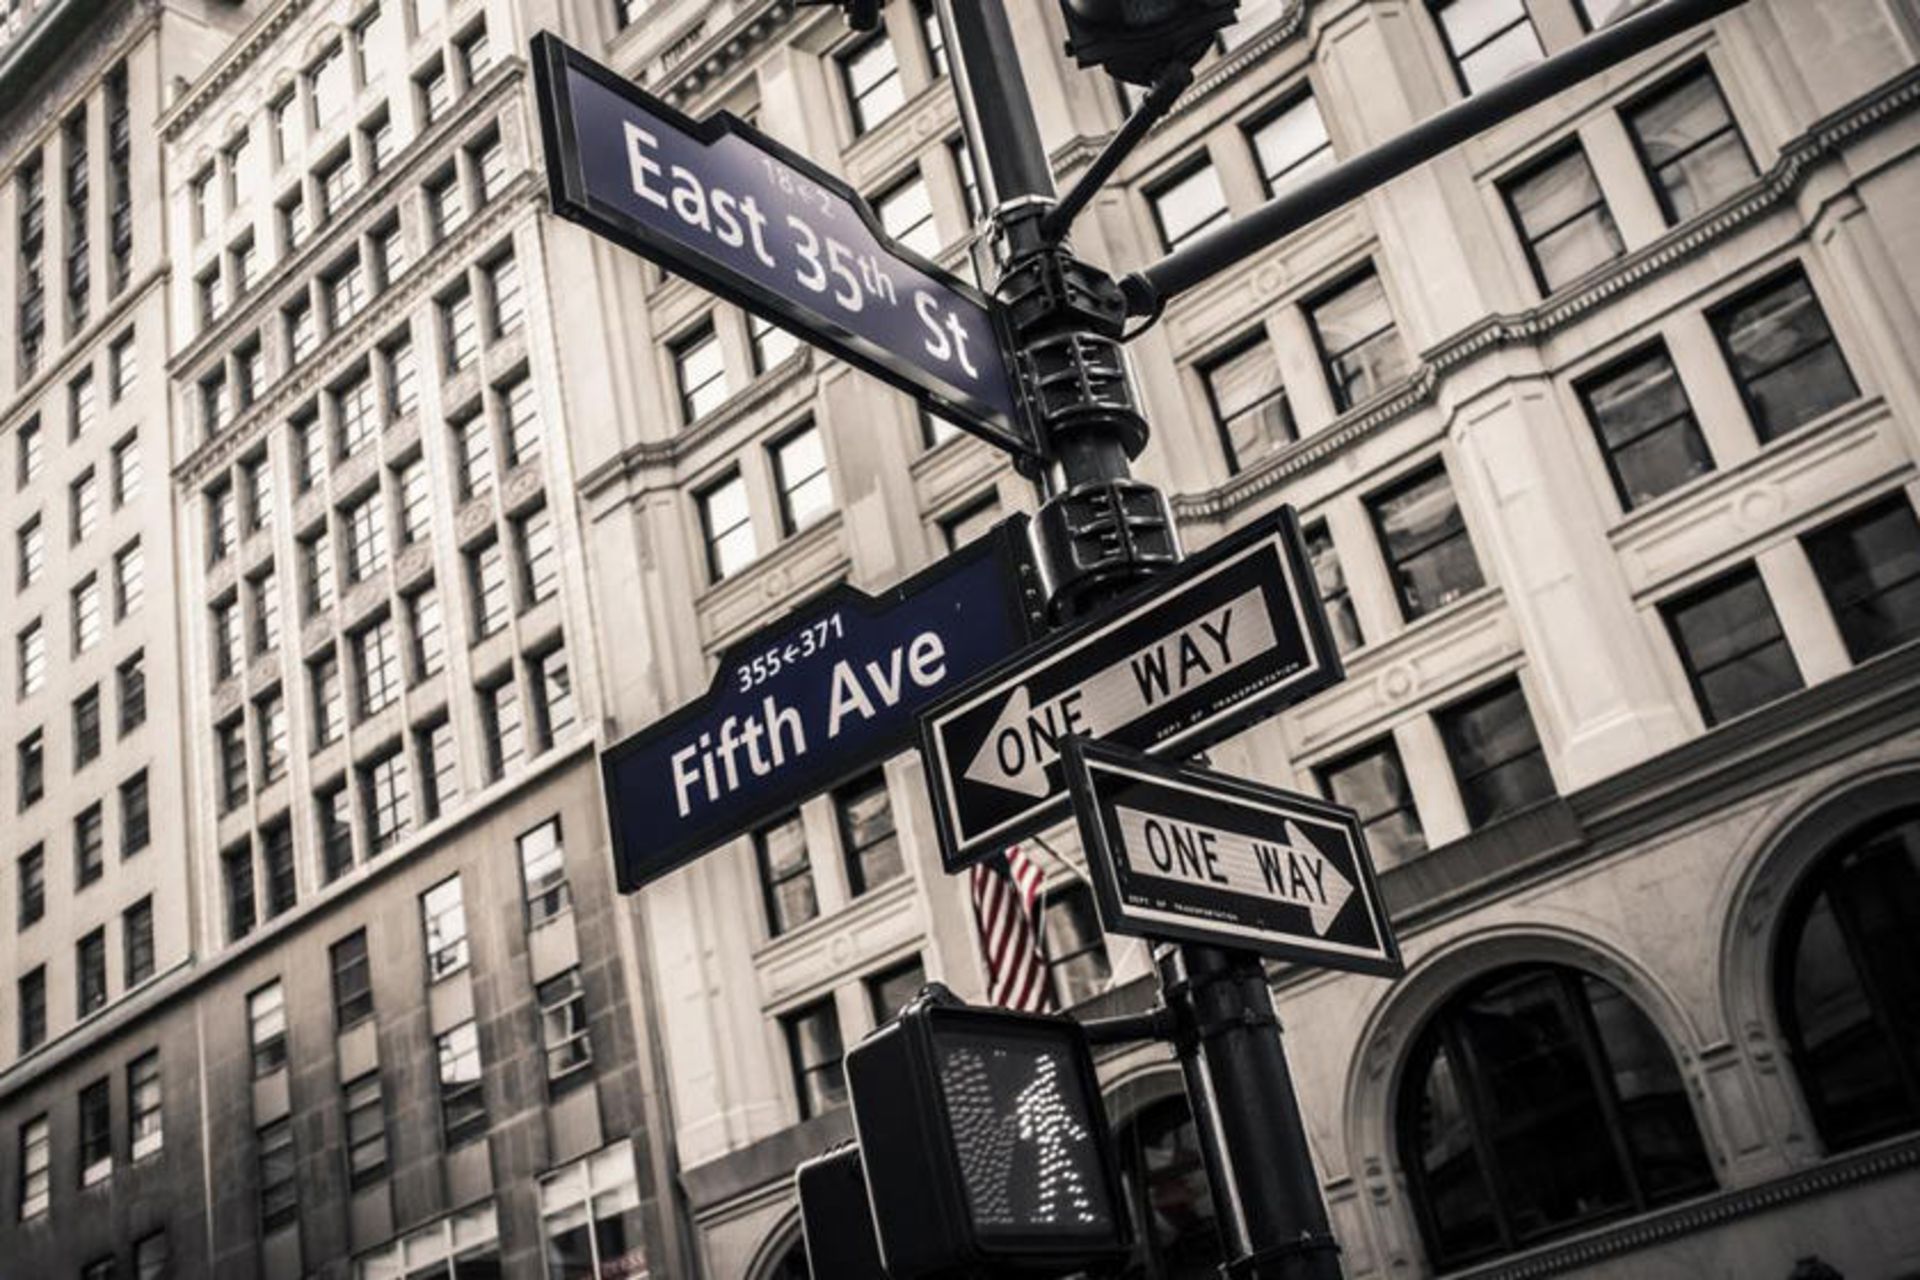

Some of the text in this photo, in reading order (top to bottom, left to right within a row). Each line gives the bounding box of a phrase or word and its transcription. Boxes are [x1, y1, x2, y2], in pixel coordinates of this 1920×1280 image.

[622, 119, 979, 379] East 35th St
[671, 630, 948, 819] Fifth Ave
[737, 612, 844, 693] 355 371
[996, 608, 1233, 778] ONE WAY
[1144, 818, 1328, 905] ONE WAY
